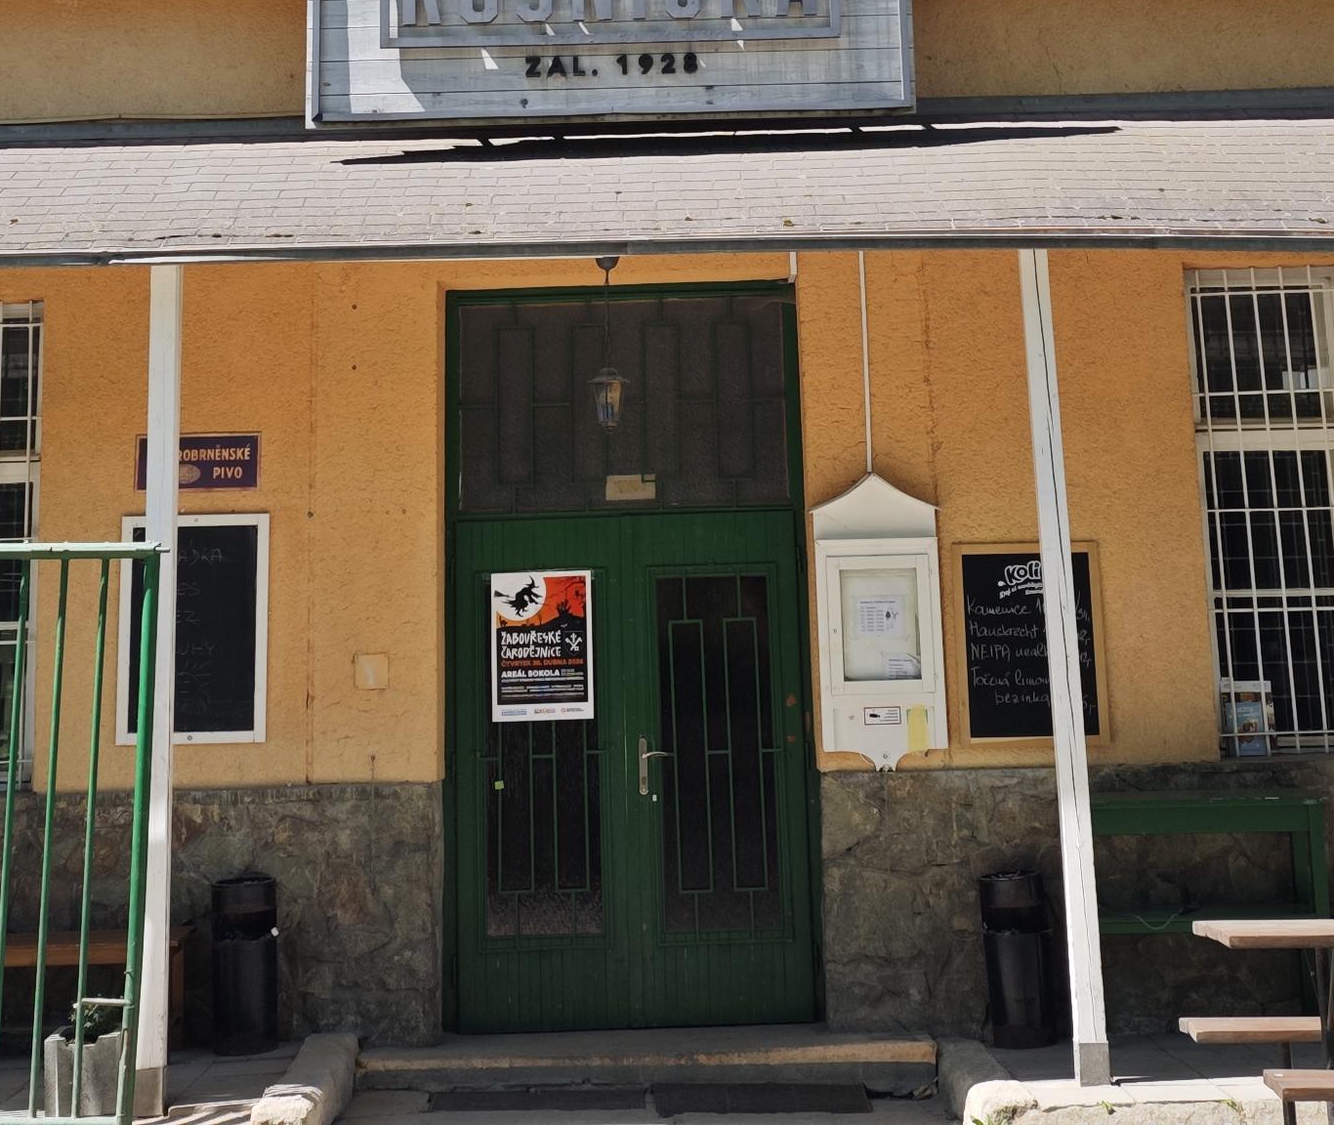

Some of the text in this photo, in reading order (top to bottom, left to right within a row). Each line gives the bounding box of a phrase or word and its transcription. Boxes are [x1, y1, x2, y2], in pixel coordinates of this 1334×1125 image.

[524, 51, 700, 79] ZAL. 1928
[178, 443, 251, 462] ROBRNĚNSKÉ
[212, 466, 243, 480] PIVO
[970, 642, 1011, 662] NEIPA
[501, 668, 527, 678] AREÁL
[527, 668, 561, 678] SOKOLA
